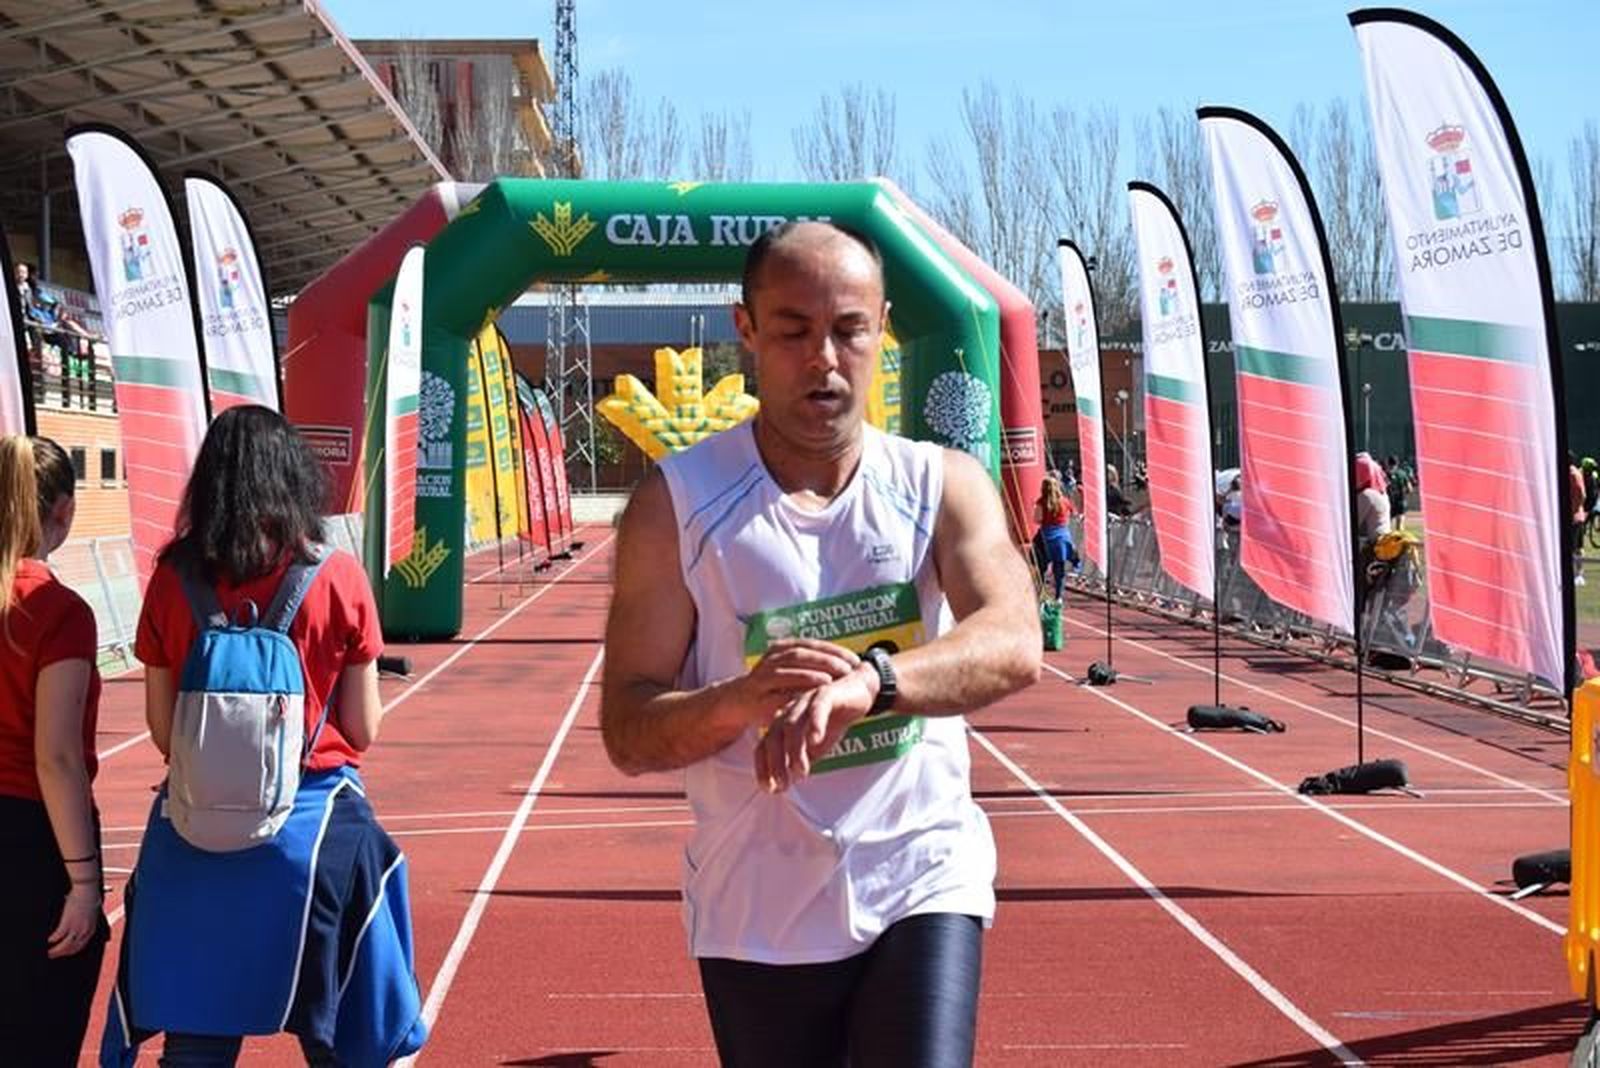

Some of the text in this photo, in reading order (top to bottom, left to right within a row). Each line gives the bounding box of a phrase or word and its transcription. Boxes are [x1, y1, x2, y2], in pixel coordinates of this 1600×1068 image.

[606, 214, 699, 247] CAJA
[797, 592, 898, 626] FUNDACION
[800, 609, 900, 640] CAJA RURAL
[822, 737, 867, 759] AJA
